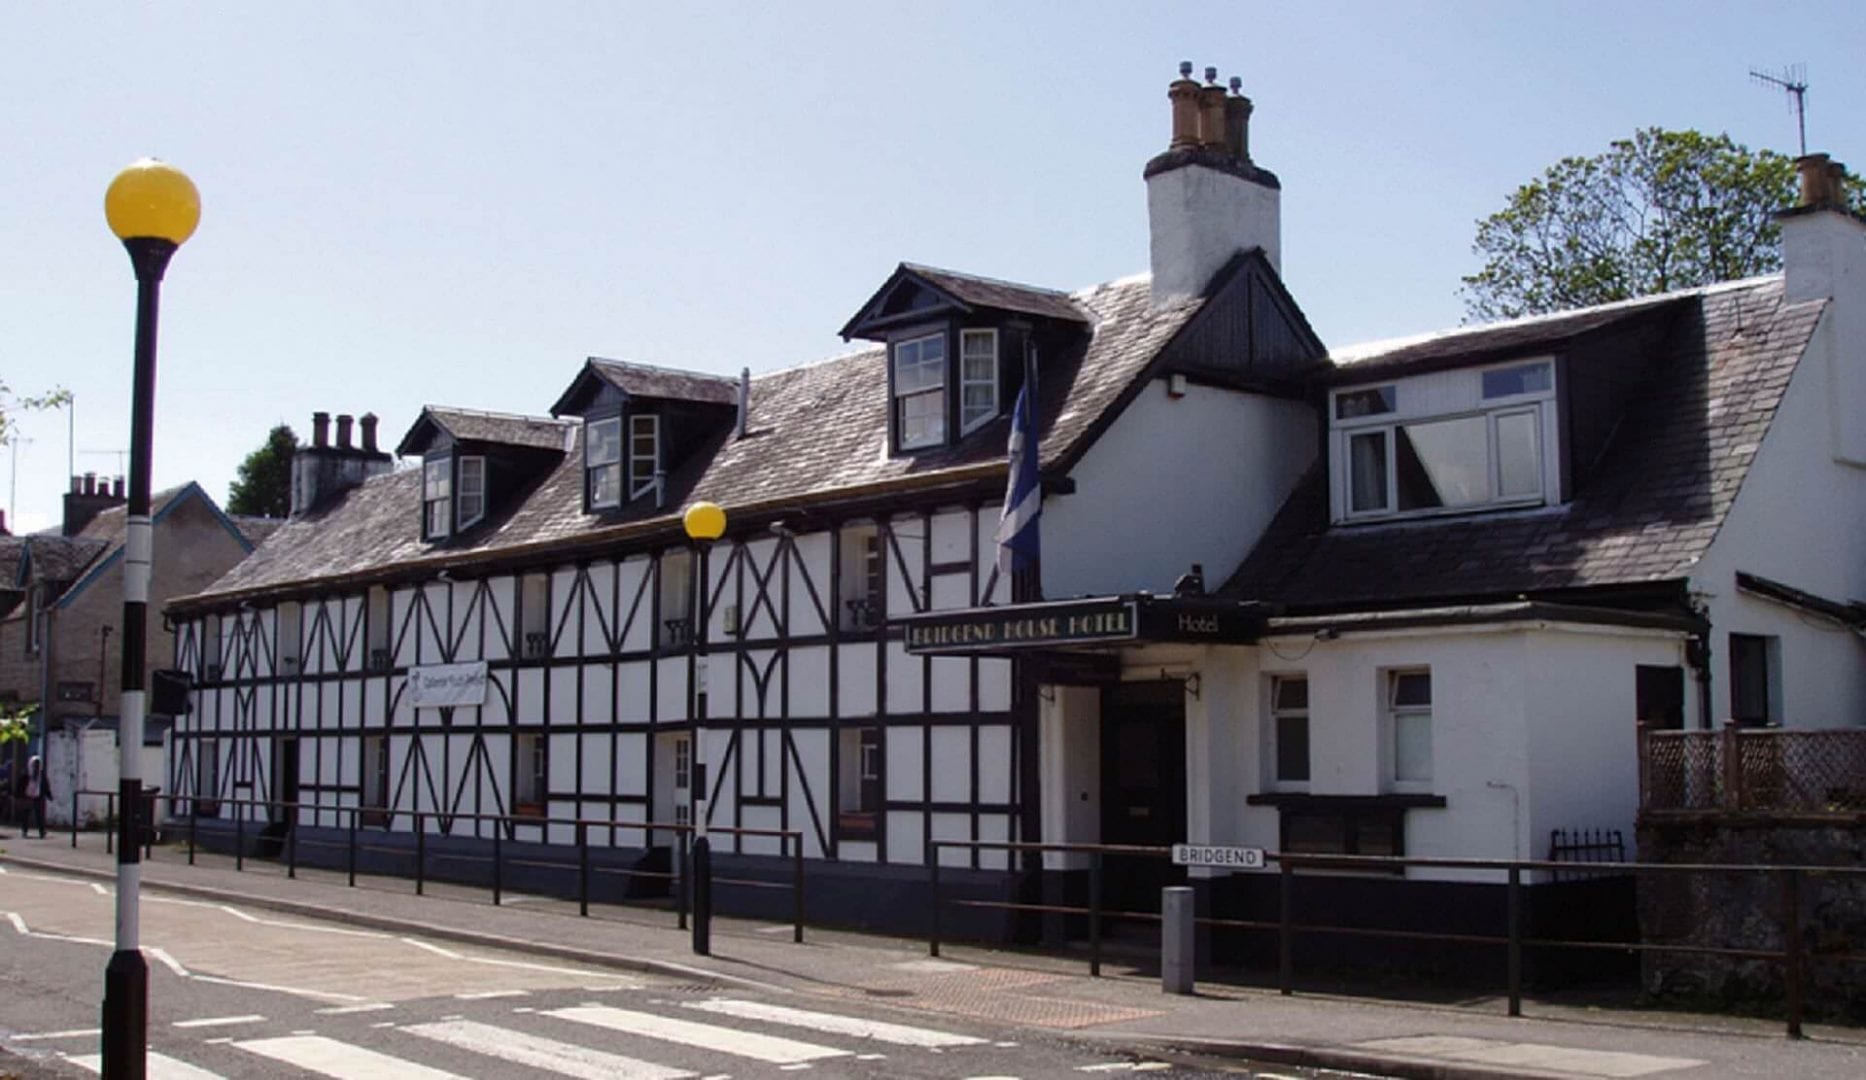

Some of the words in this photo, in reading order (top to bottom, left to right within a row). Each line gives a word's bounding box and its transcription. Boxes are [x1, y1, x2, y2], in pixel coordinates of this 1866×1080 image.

[913, 623, 996, 645] BRIDGEND
[1004, 617, 1059, 640] HOUSE
[1069, 612, 1128, 635] HOTEL
[1178, 613, 1220, 633] Hotel
[1180, 847, 1257, 865] BRIDGEND
